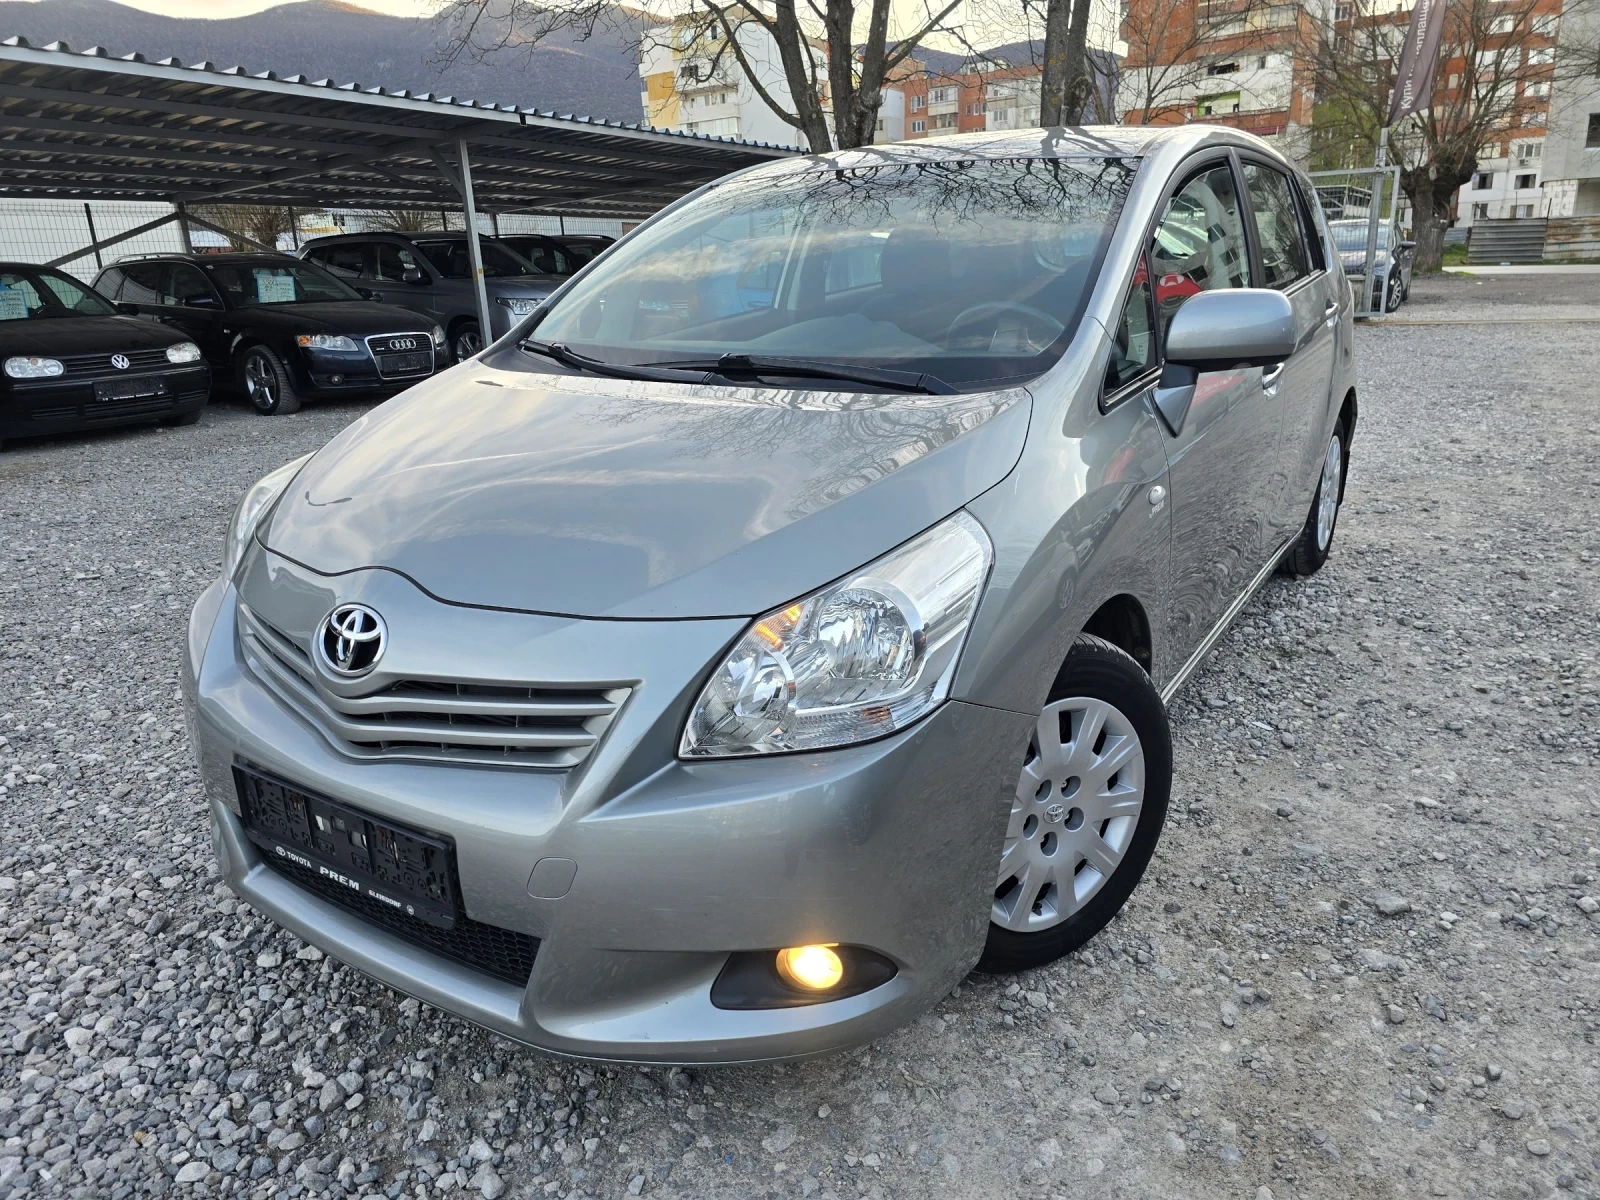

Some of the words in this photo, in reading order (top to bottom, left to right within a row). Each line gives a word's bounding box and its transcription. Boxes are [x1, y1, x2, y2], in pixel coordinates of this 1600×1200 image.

[1401, 79, 1414, 110] Купи
[287, 851, 312, 868] TOYOTA
[319, 866, 360, 891] PREM
